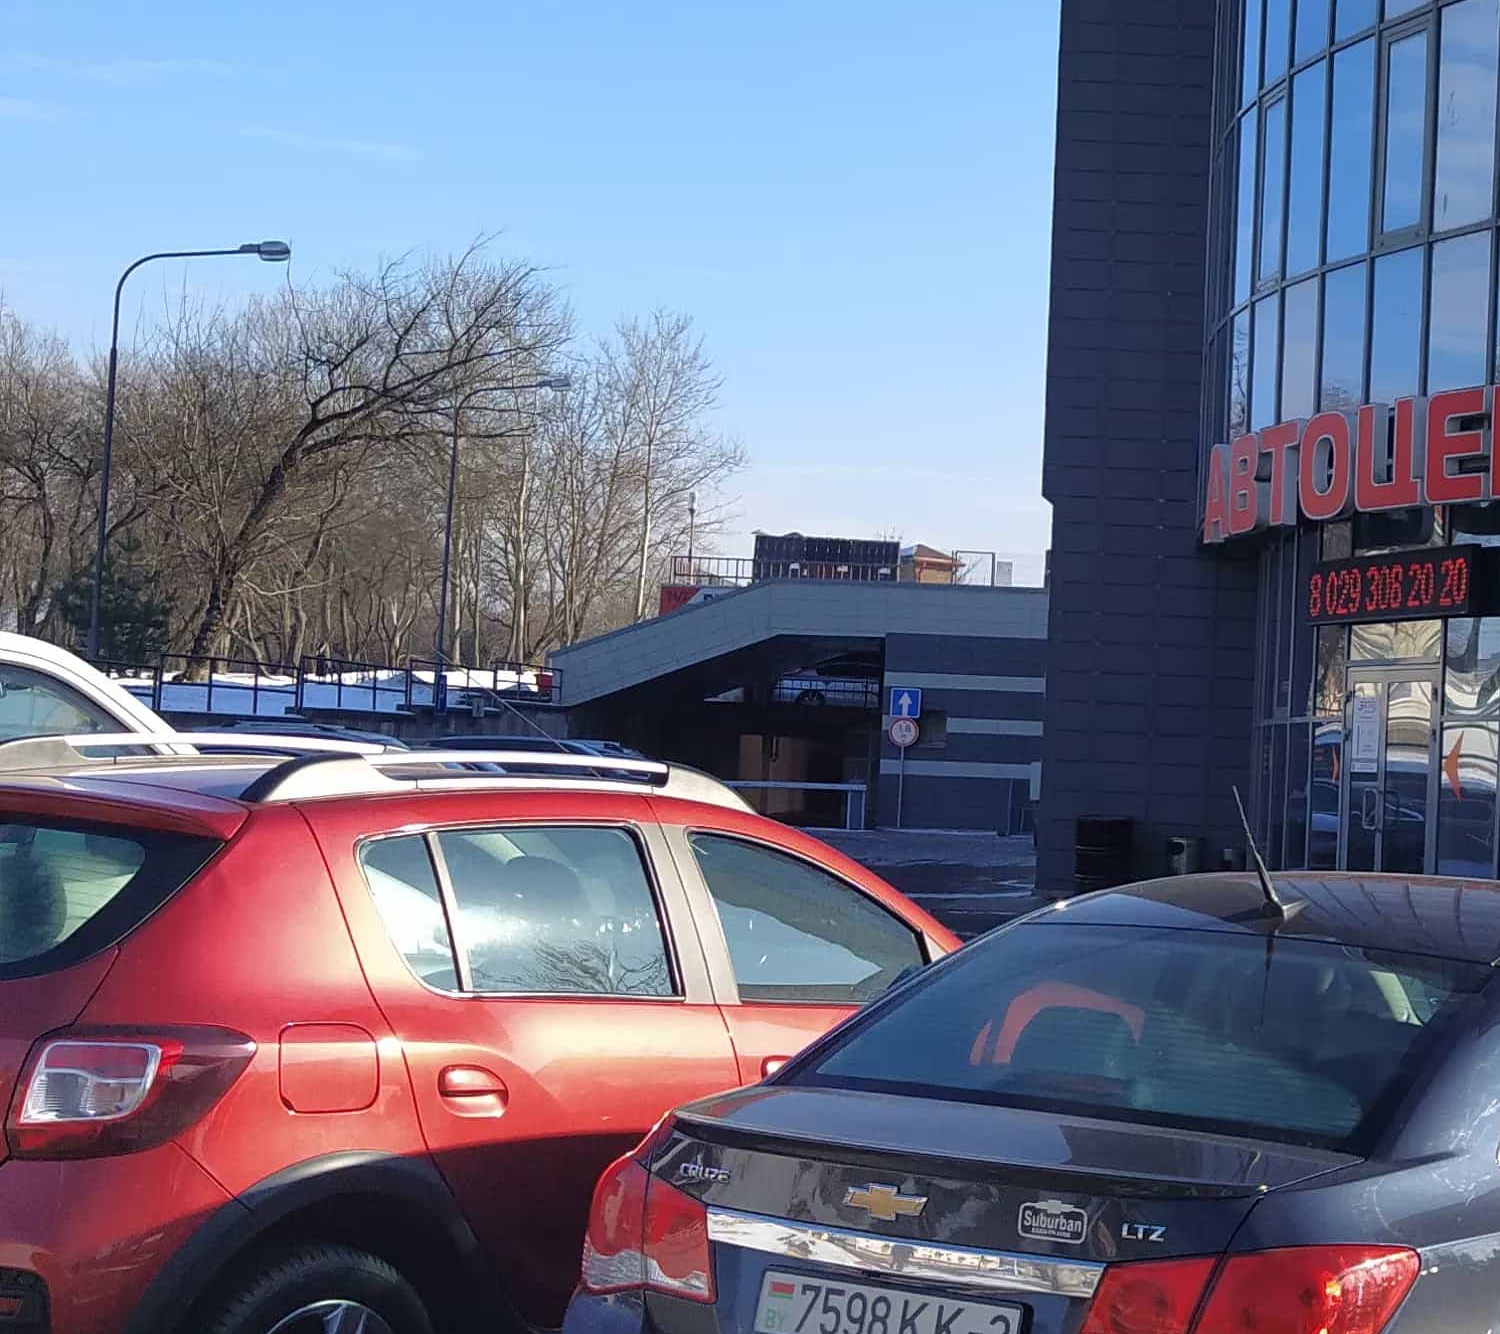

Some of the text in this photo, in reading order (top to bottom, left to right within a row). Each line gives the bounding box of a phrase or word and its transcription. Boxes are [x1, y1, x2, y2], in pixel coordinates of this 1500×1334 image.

[1310, 573, 1323, 616] 8
[1325, 568, 1361, 615] 029
[1408, 562, 1434, 607] 20
[1439, 557, 1468, 606] 20
[1023, 1210, 1083, 1233] Suburban
[1121, 1222, 1168, 1243] LTZ
[764, 1308, 785, 1330] BY
